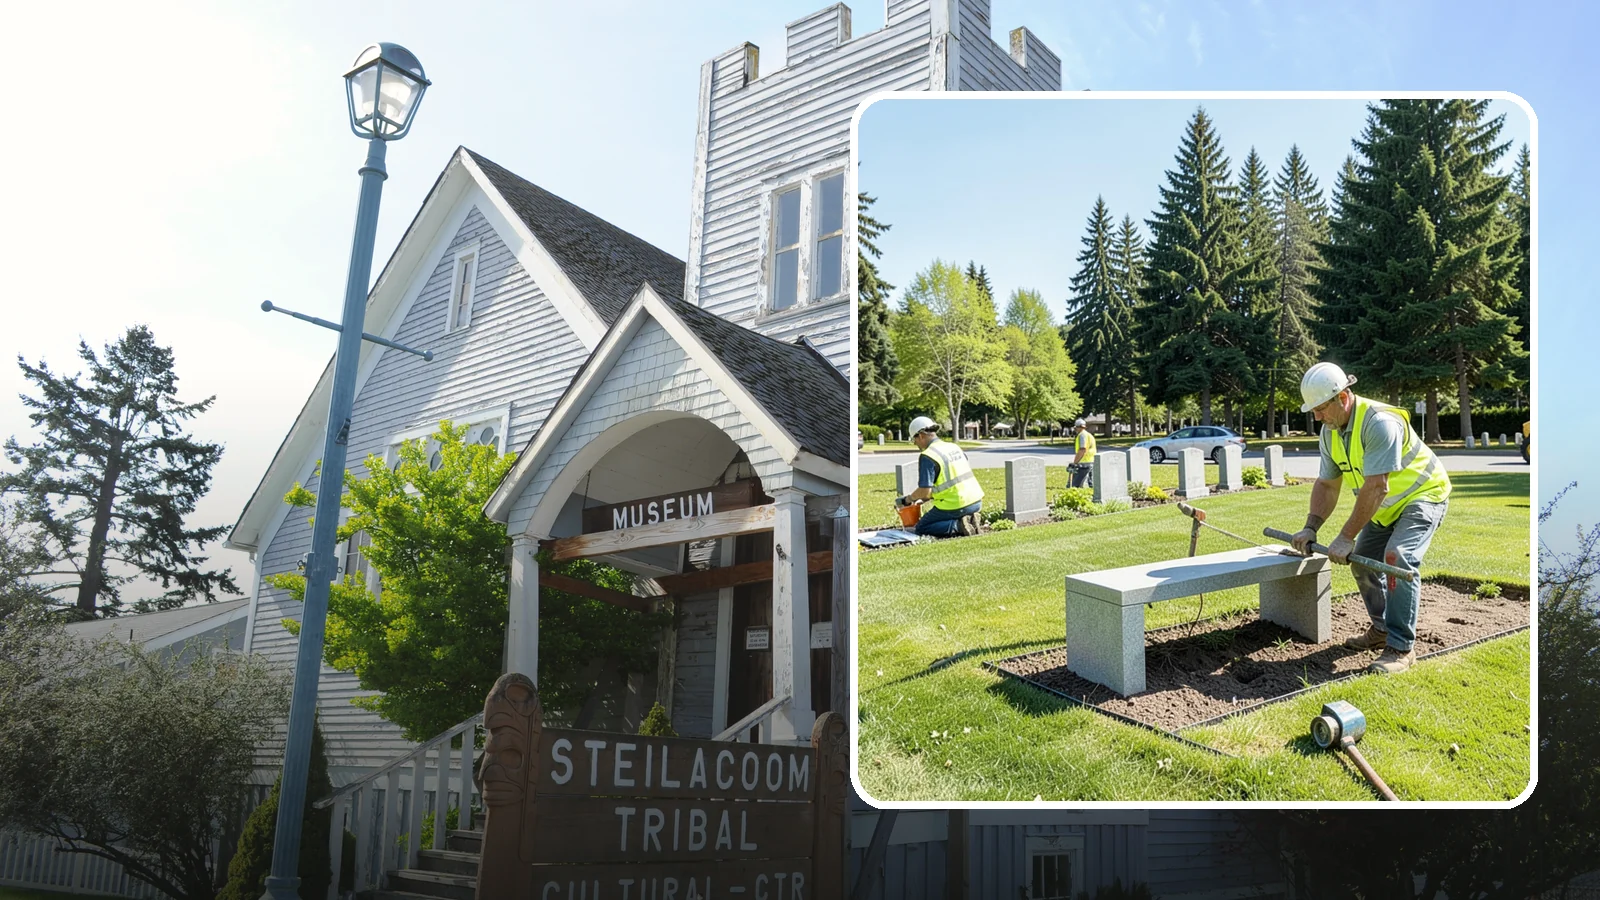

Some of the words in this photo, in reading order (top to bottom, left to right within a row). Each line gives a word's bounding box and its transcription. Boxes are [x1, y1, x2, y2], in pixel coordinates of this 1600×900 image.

[612, 491, 715, 531] MUSEUM
[550, 738, 810, 793] STEILACOOM
[614, 806, 758, 852] TRIBAL
